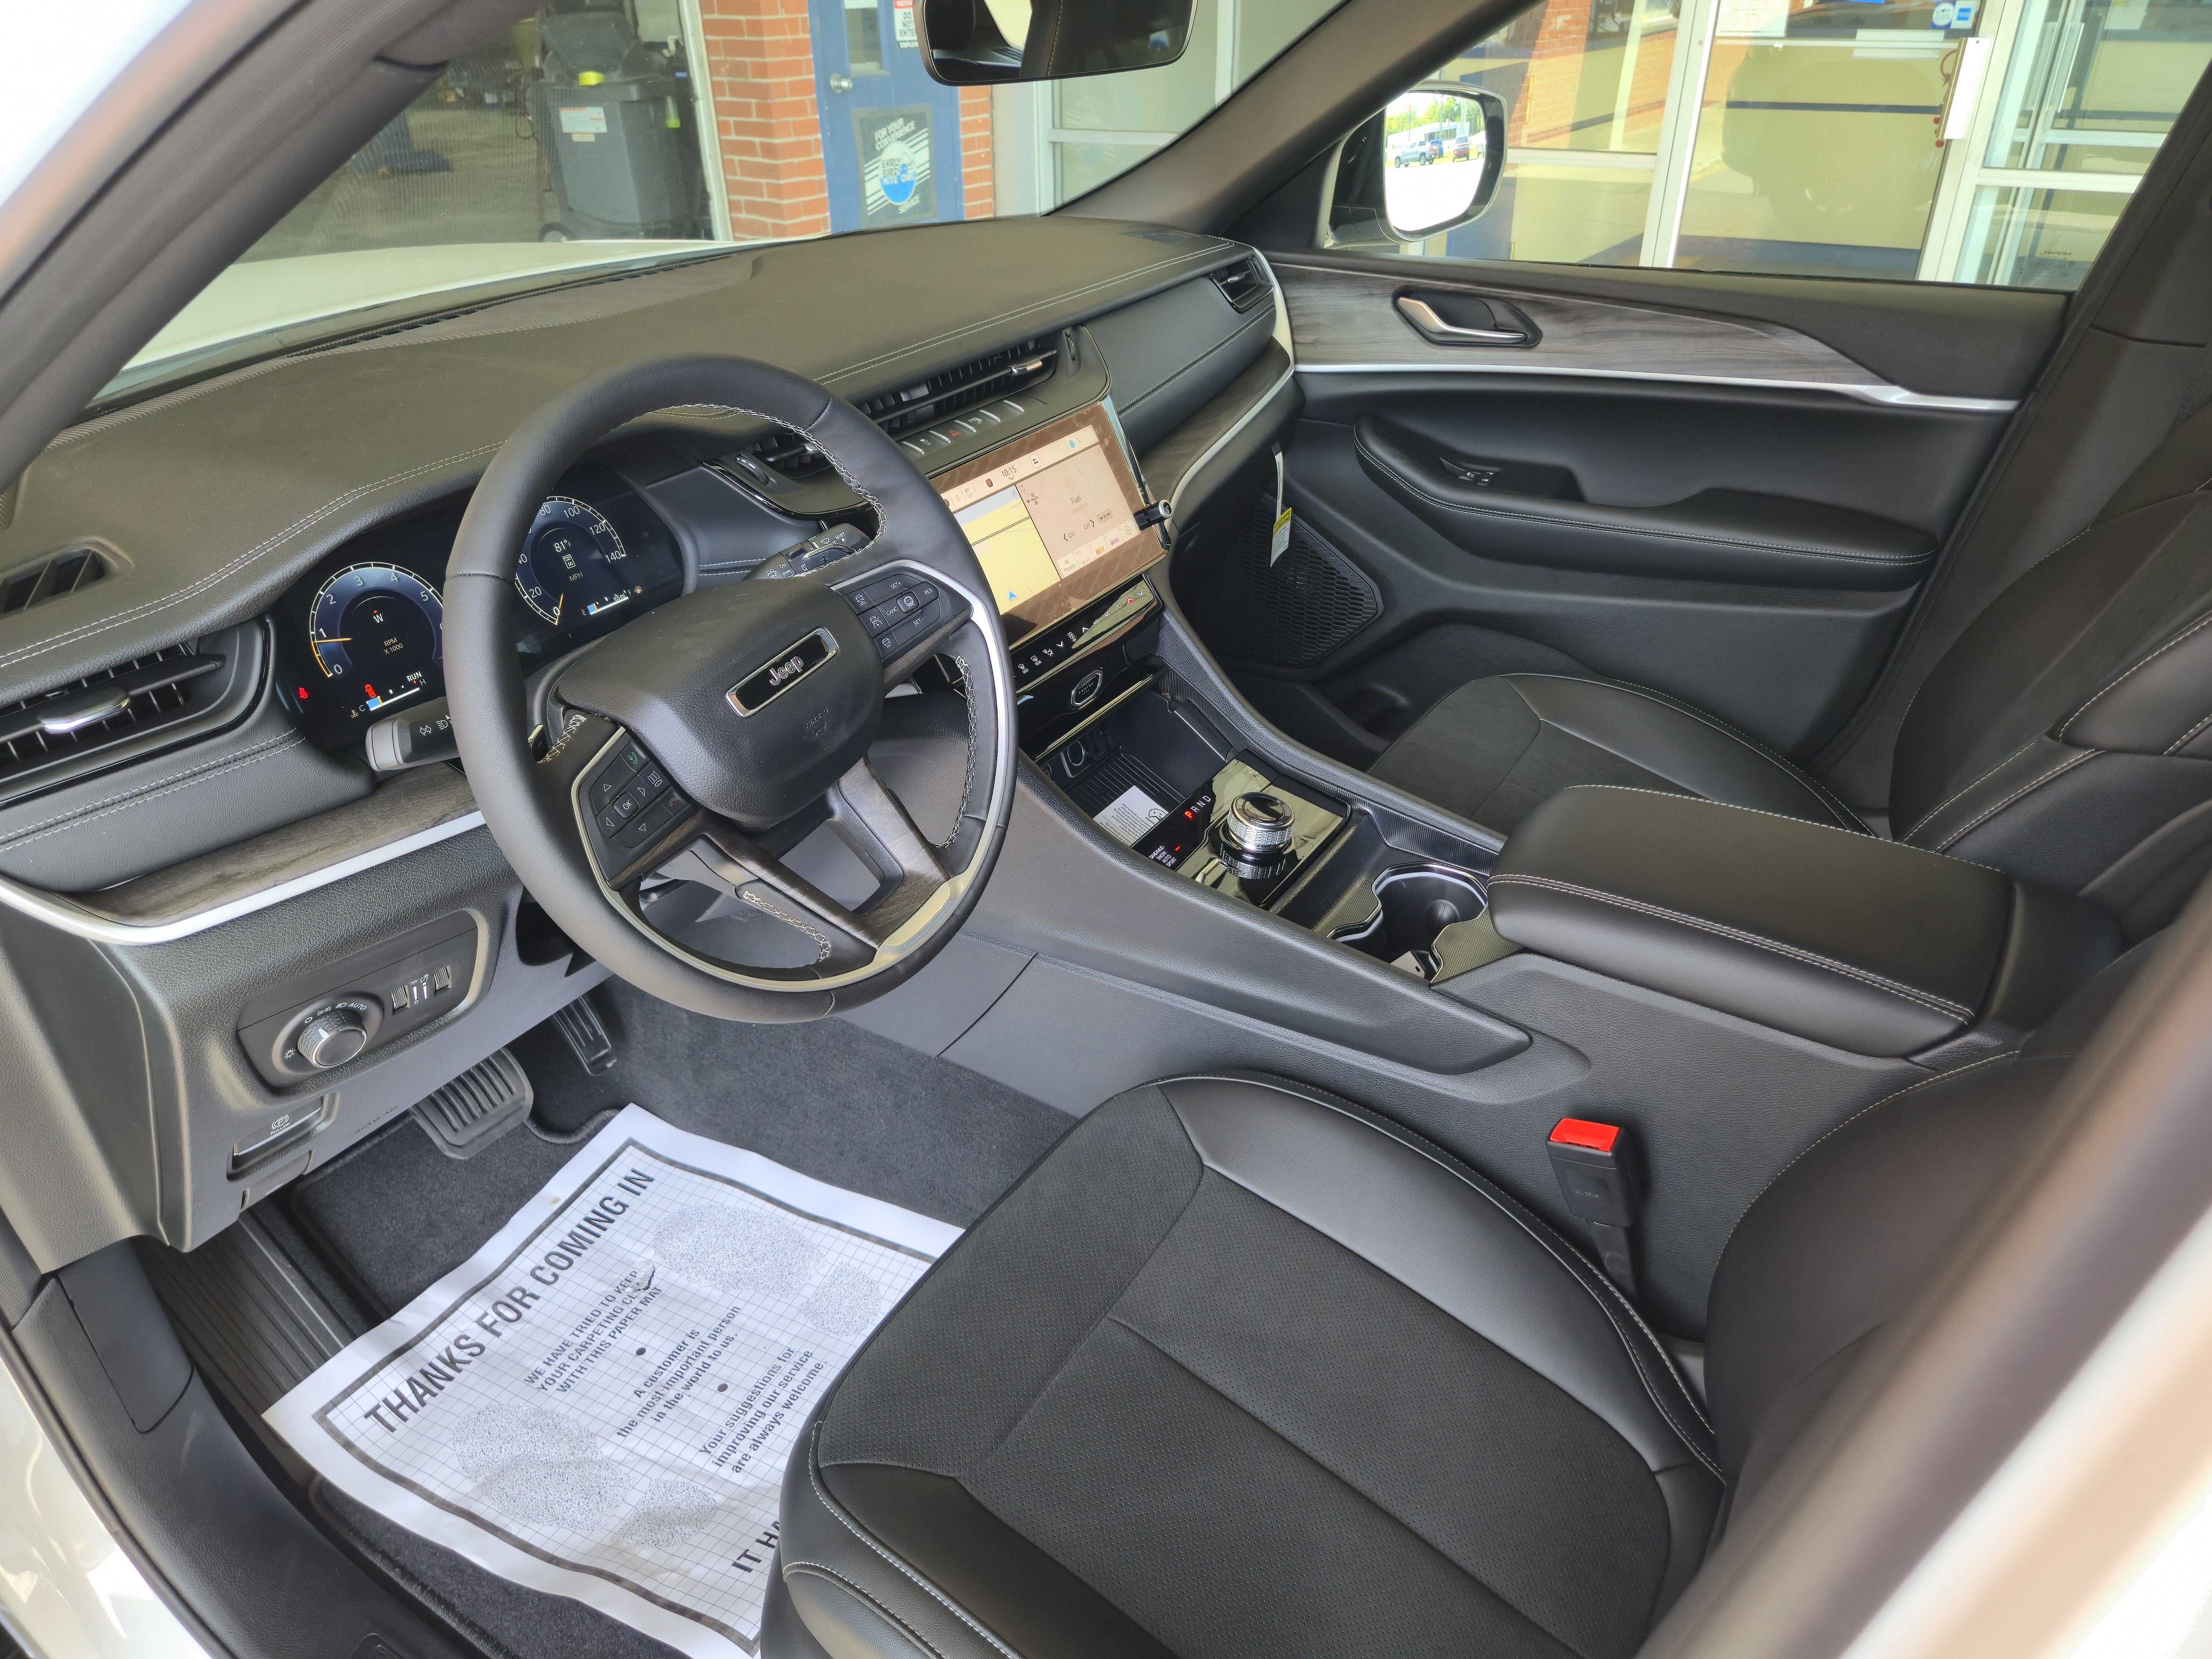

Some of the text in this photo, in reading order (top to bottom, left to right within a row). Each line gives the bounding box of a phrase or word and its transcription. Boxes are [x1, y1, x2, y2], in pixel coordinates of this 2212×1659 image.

[1002, 465, 1017, 477] 10:15
[1071, 495, 1082, 505] Fuel
[540, 505, 551, 516] 80
[563, 506, 580, 518] 100
[1071, 502, 1088, 514] Metallica
[589, 523, 606, 535] 120
[834, 532, 846, 540] MIST
[1095, 546, 1105, 555] HEAT
[606, 551, 622, 563] 140
[1064, 563, 1076, 573] Presets
[354, 576, 363, 586] 3
[391, 572, 398, 582] 4
[569, 571, 583, 582] MPH
[890, 581, 902, 589] SET+
[421, 591, 428, 601] 5
[529, 587, 542, 598] 20
[327, 594, 336, 605] 2
[553, 606, 561, 616] 0
[886, 606, 899, 616] CANC
[373, 613, 384, 623] W
[319, 628, 327, 638] 1
[384, 637, 398, 647] RPM
[389, 643, 404, 653] 1000
[334, 664, 343, 674] 0
[769, 656, 804, 686] Jeep
[407, 671, 422, 682] RUN
[623, 800, 633, 810] OK
[1117, 811, 1126, 819] check
[1121, 806, 1132, 815] climate
[1131, 815, 1141, 823] control
[1128, 808, 1138, 816] vehicle
[1184, 811, 1193, 819] P
[1111, 816, 1128, 829] preferences,
[1119, 818, 1128, 826] adjust
[1103, 825, 1119, 838] commande
[1149, 846, 1165, 859] SAND/MUD
[1156, 851, 1167, 861] SNOW
[1162, 854, 1172, 864] AUTO
[1166, 857, 1177, 867] SPORT
[270, 1126, 282, 1136] PULL
[364, 1168, 655, 1433] THANKS FOR COMING IN
[524, 1366, 546, 1384] WE
[543, 1339, 573, 1367] HAVE
[569, 1309, 602, 1339] TRIED
[599, 1294, 616, 1307] TO
[614, 1270, 637, 1293] KEEP
[556, 1364, 588, 1392] WITH
[584, 1340, 611, 1364] THIS
[608, 1306, 643, 1339] PAPER
[639, 1286, 663, 1306] MAT
[538, 1306, 624, 1392] YOUR CARPETING
[634, 1329, 700, 1398] A customer is
[616, 1305, 741, 1438] the most important person
[651, 1333, 738, 1422] in the world to us.
[699, 1347, 796, 1454] Your suggestions for
[712, 1350, 813, 1467] improving our service
[732, 1361, 827, 1473] are always welcome.
[731, 1548, 762, 1573] IT
